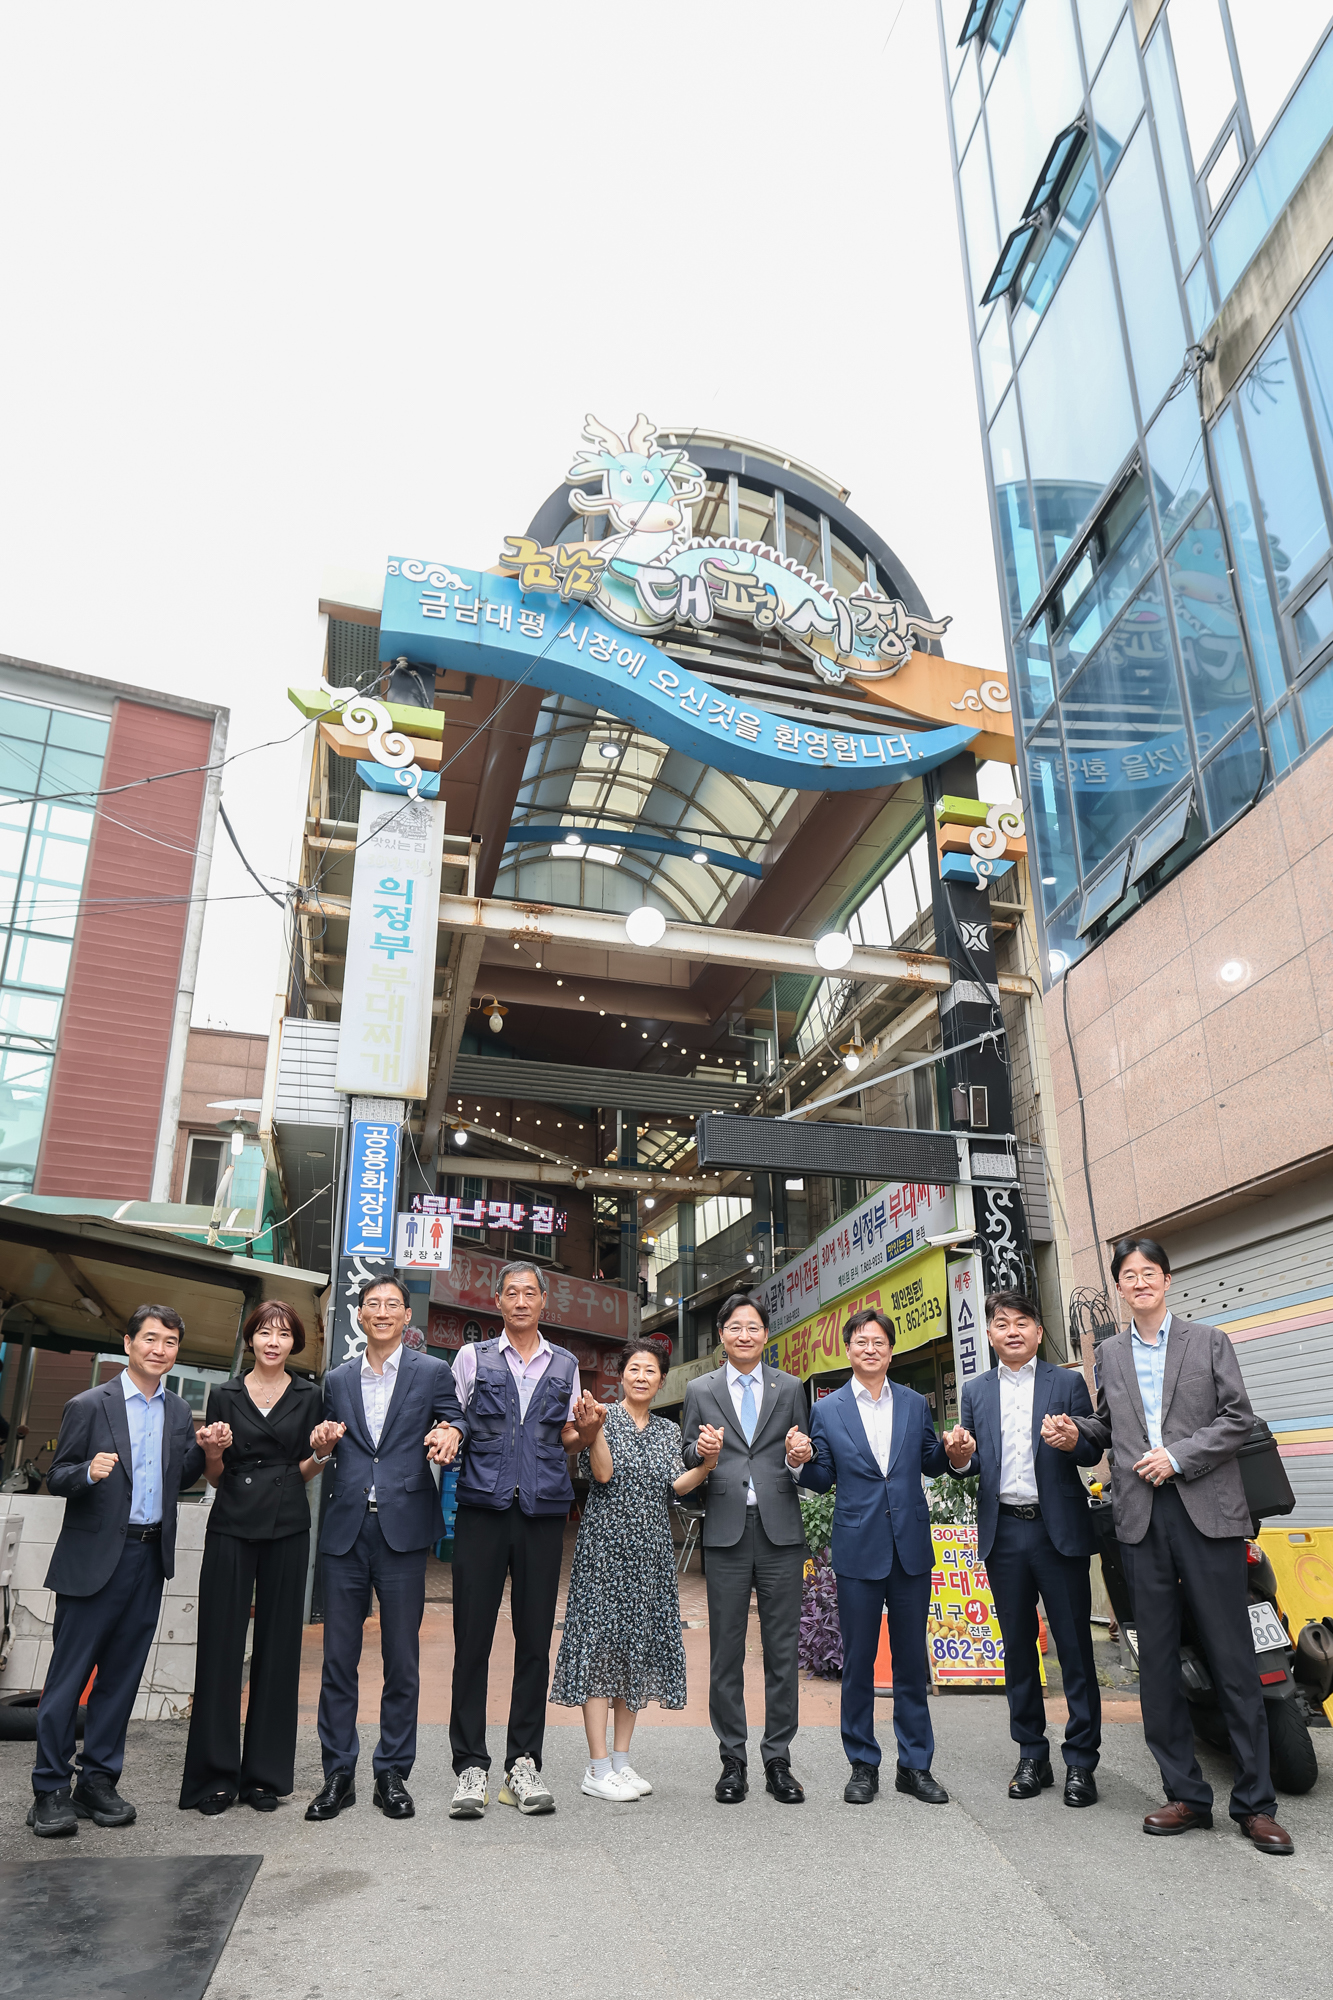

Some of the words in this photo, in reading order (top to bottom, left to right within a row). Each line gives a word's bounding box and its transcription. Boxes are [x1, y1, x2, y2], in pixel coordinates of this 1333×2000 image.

[418, 589, 546, 638] 금남대평
[558, 621, 647, 678] 시장에
[649, 668, 762, 742] 오신것을
[773, 723, 924, 763] 환영합니다.
[369, 875, 415, 961] 의정부
[360, 962, 412, 1084] 부대찌개
[357, 1125, 391, 1239] 공용화장실
[852, 1200, 887, 1252] 의정부
[954, 1270, 972, 1292] 세종
[969, 1626, 992, 1637] 전문
